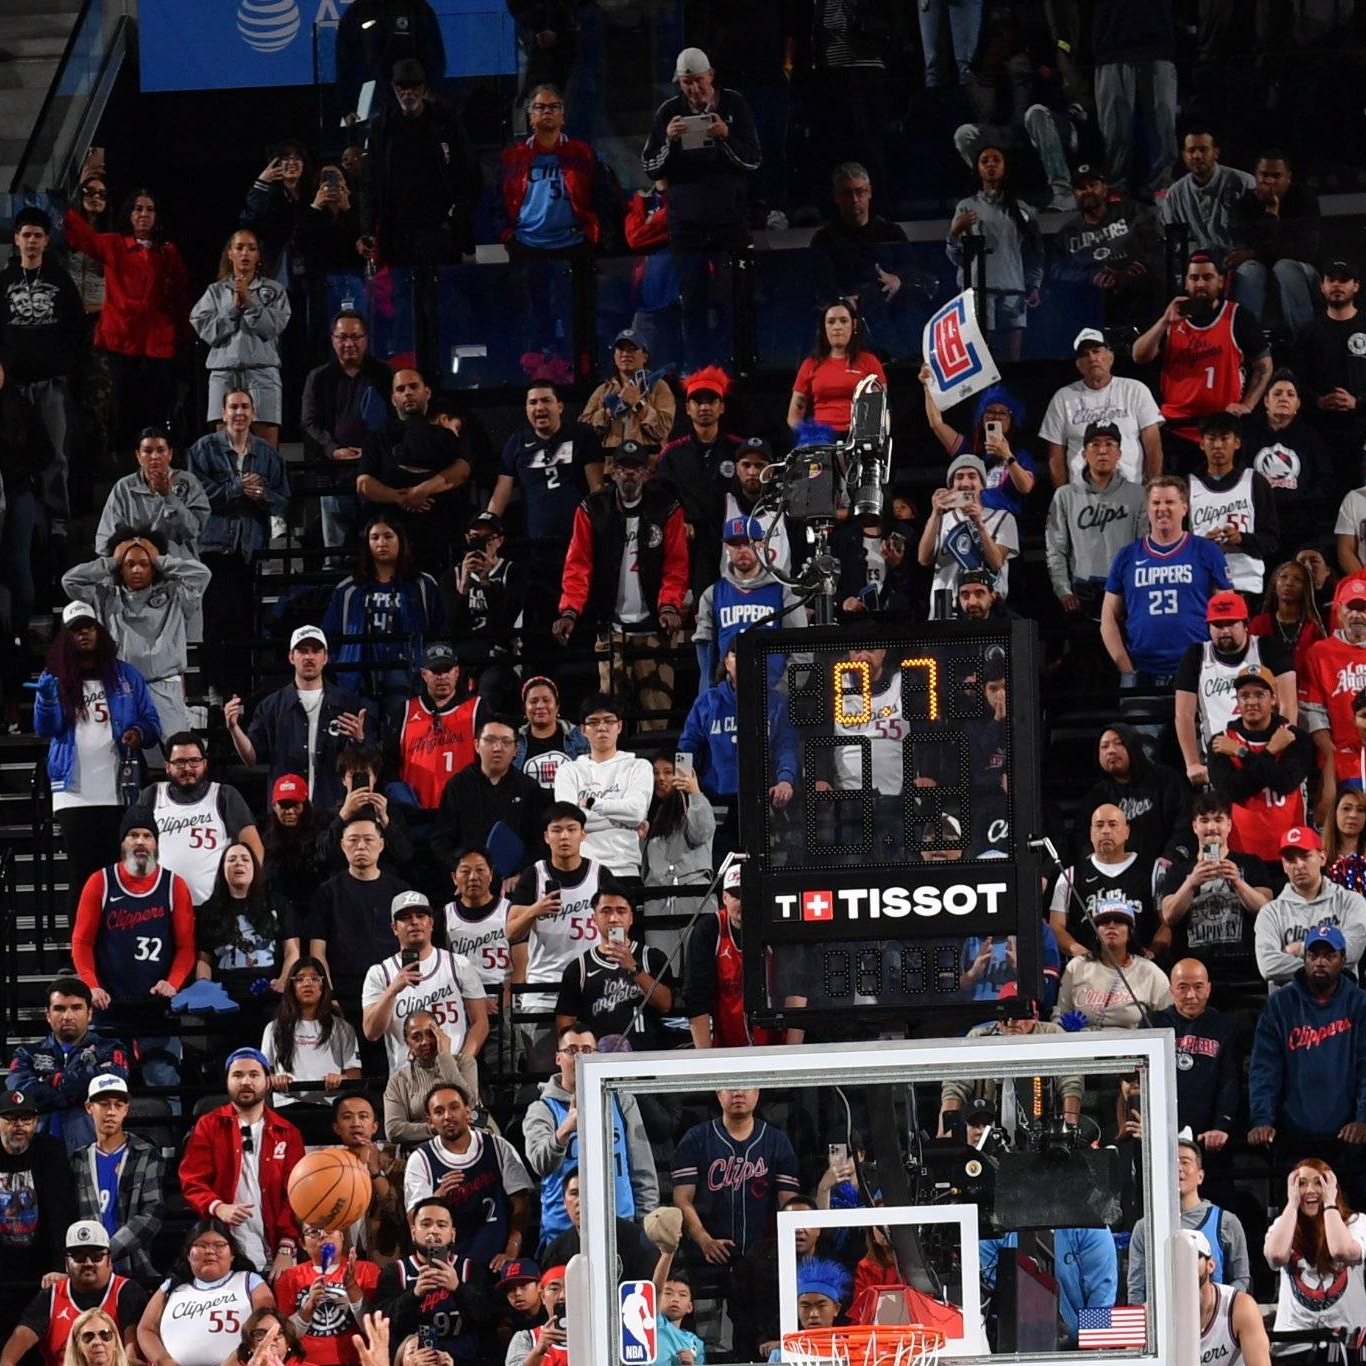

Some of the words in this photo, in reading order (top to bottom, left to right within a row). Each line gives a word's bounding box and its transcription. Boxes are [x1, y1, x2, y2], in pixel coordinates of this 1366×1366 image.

[1069, 217, 1128, 255] CLIPPERS
[1205, 367, 1216, 389] 1
[546, 467, 560, 489] 2
[1078, 505, 1127, 532] Clips
[1194, 497, 1249, 528] Clippers
[1134, 563, 1193, 588] CLIPPERS
[1148, 591, 1178, 616] 23
[1203, 678, 1239, 698] Clipp
[875, 719, 902, 739] 55
[442, 751, 453, 772] 1
[153, 811, 214, 837] Clippers
[189, 826, 217, 850] 55
[838, 882, 1008, 919] TISSOT
[106, 903, 166, 932] Clippers
[569, 916, 599, 941] 55
[133, 935, 163, 962] 32
[449, 928, 506, 957] Clippers
[481, 948, 511, 971] 55
[591, 983, 646, 1016] angeles
[603, 977, 629, 997] los
[1075, 987, 1132, 1010] Clippers
[394, 983, 454, 1020] Clippers
[430, 999, 460, 1024] 55
[1288, 1015, 1353, 1052] Clippers
[1176, 1034, 1220, 1060] PPERS
[706, 1155, 770, 1194] Clips
[482, 1197, 499, 1224] 2
[171, 1289, 238, 1322] Clippers
[207, 1310, 241, 1335] 55
[432, 1310, 463, 1337] 97
[625, 1345, 644, 1360] NBA
